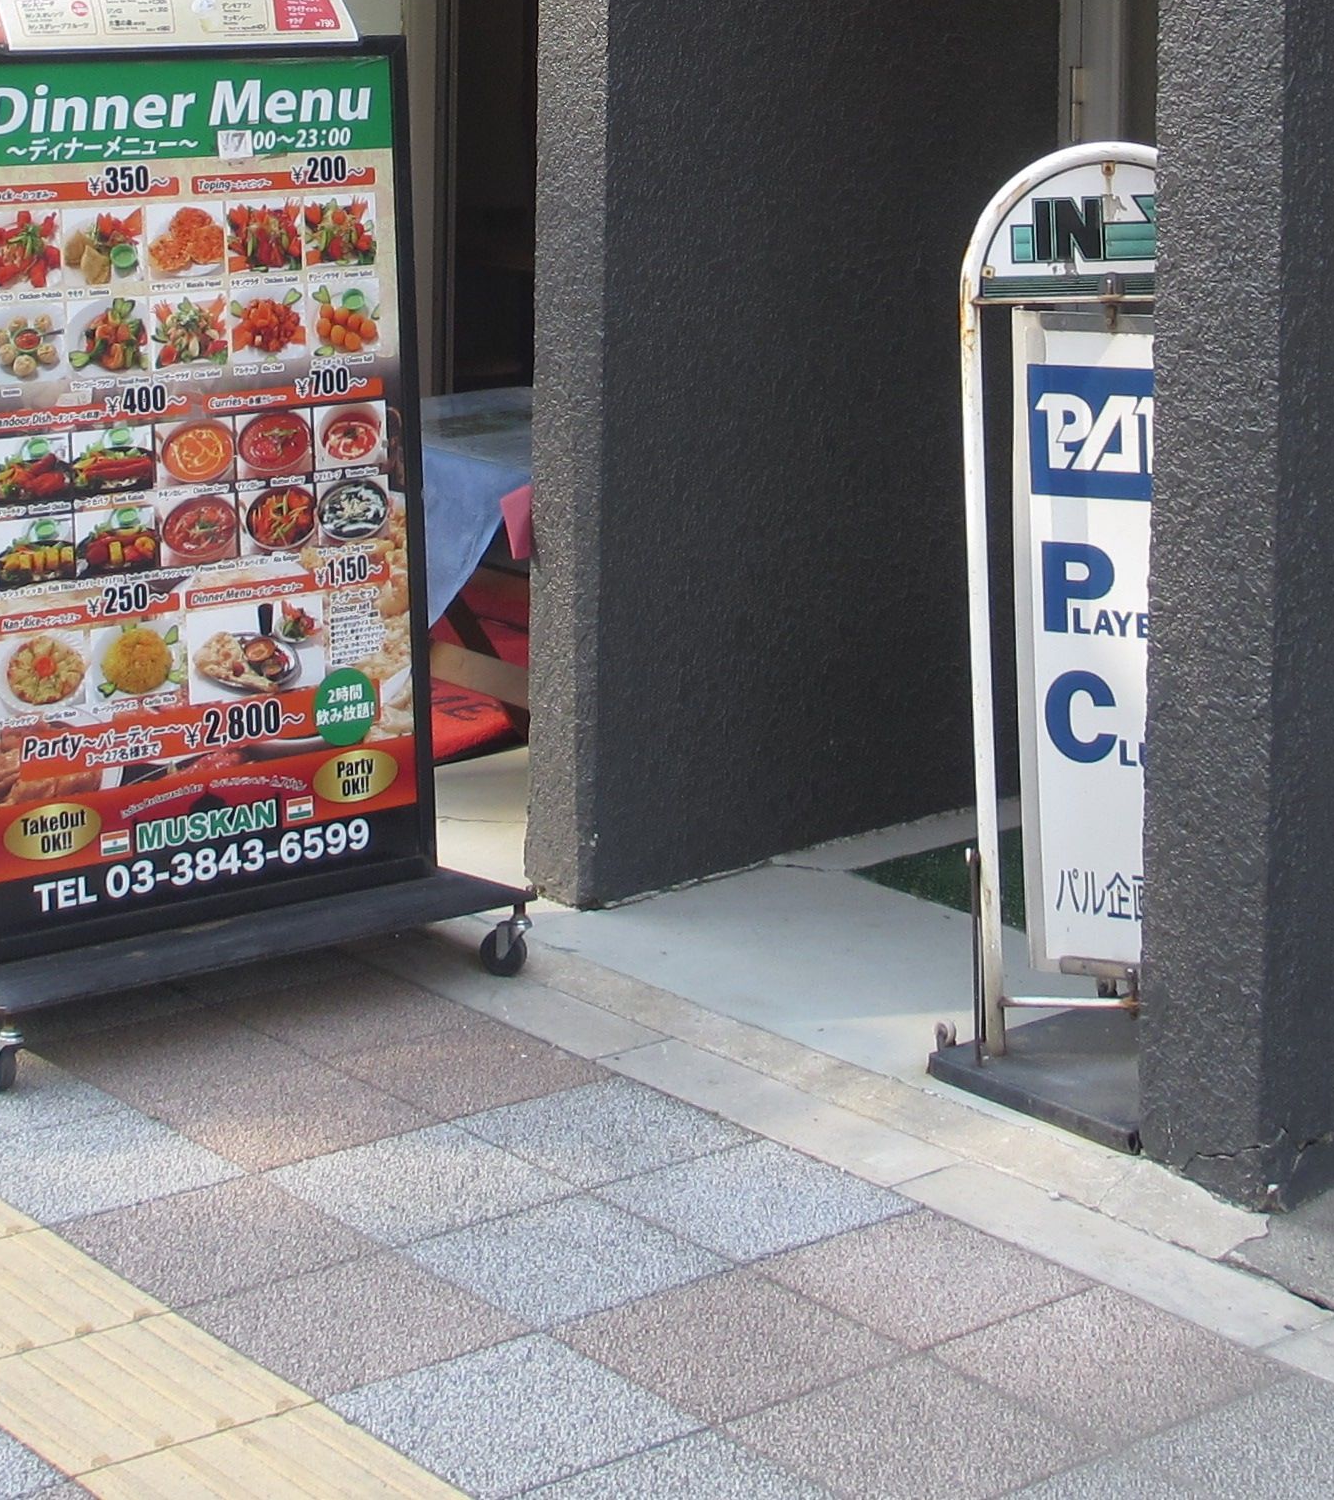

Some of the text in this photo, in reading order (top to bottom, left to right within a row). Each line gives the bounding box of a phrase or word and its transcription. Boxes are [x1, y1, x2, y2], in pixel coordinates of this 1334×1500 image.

[209, 79, 371, 126] Menu
[197, 178, 231, 191] Toping
[208, 396, 242, 408] Curries
[32, 413, 52, 426] Dish
[226, 588, 252, 601] Menu
[327, 683, 363, 704] 2時間
[316, 702, 375, 726] 飲み放題!
[23, 735, 81, 760] Party
[336, 756, 375, 779] Party
[342, 776, 370, 797] OK!!
[21, 809, 86, 836] TakeOut
[136, 799, 278, 853] MUSKAN
[41, 832, 73, 854] OK!!
[33, 818, 370, 912] TEL 03-3843-6599
